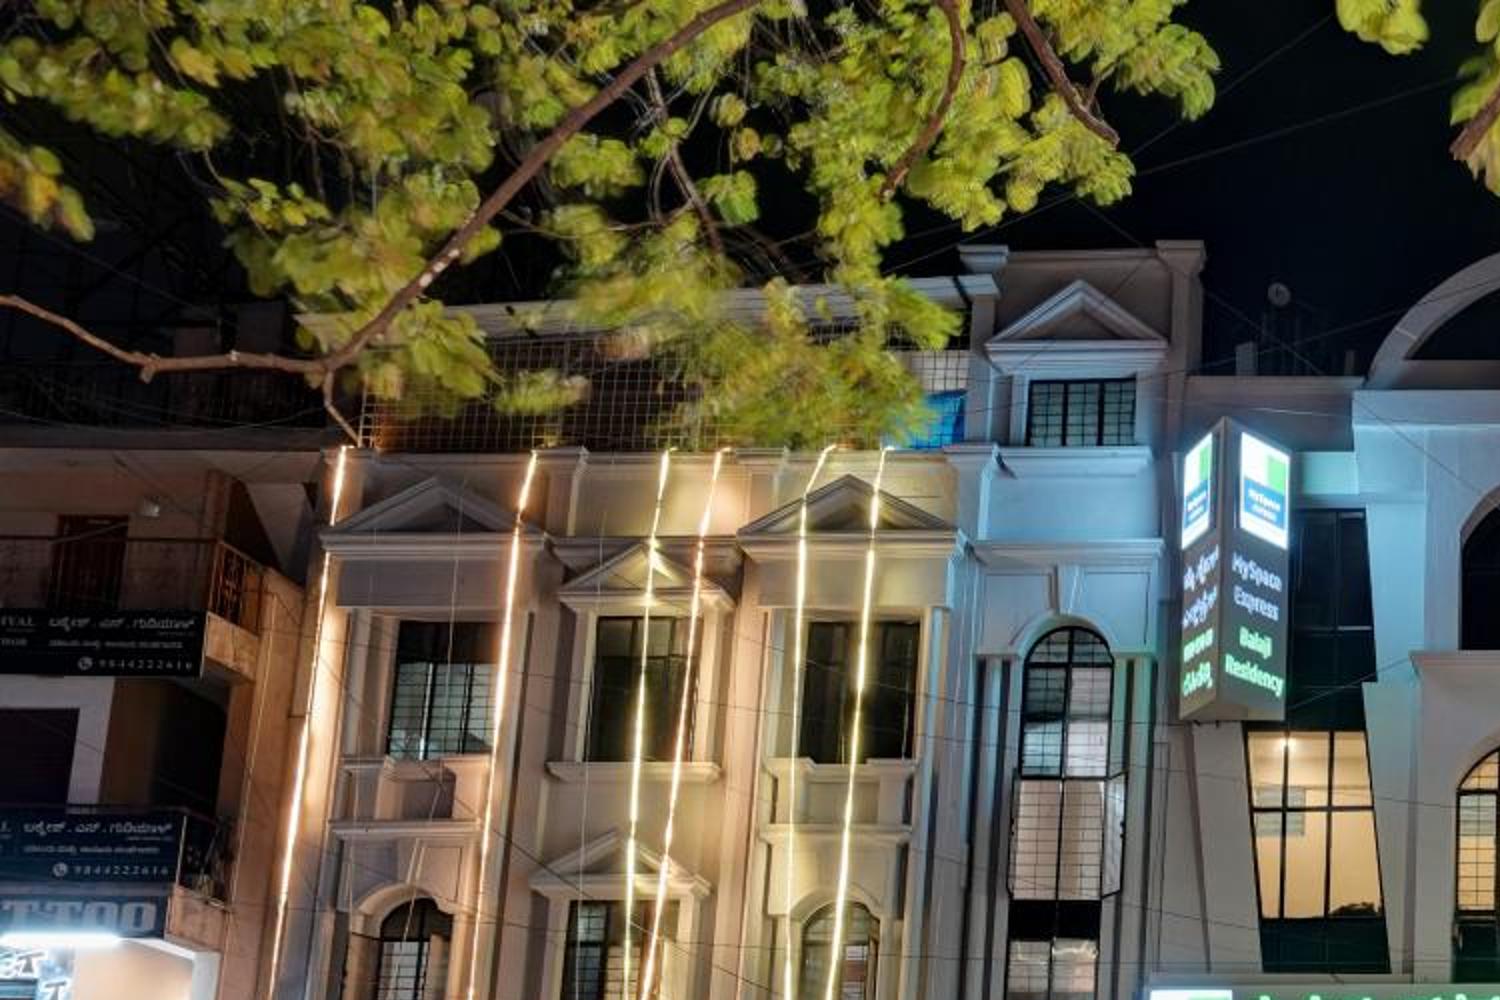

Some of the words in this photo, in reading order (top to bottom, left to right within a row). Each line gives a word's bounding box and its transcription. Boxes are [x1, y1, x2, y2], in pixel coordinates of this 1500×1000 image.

[1232, 551, 1282, 592] MySpace
[1234, 584, 1279, 621] Express
[1225, 653, 1284, 698] Residency
